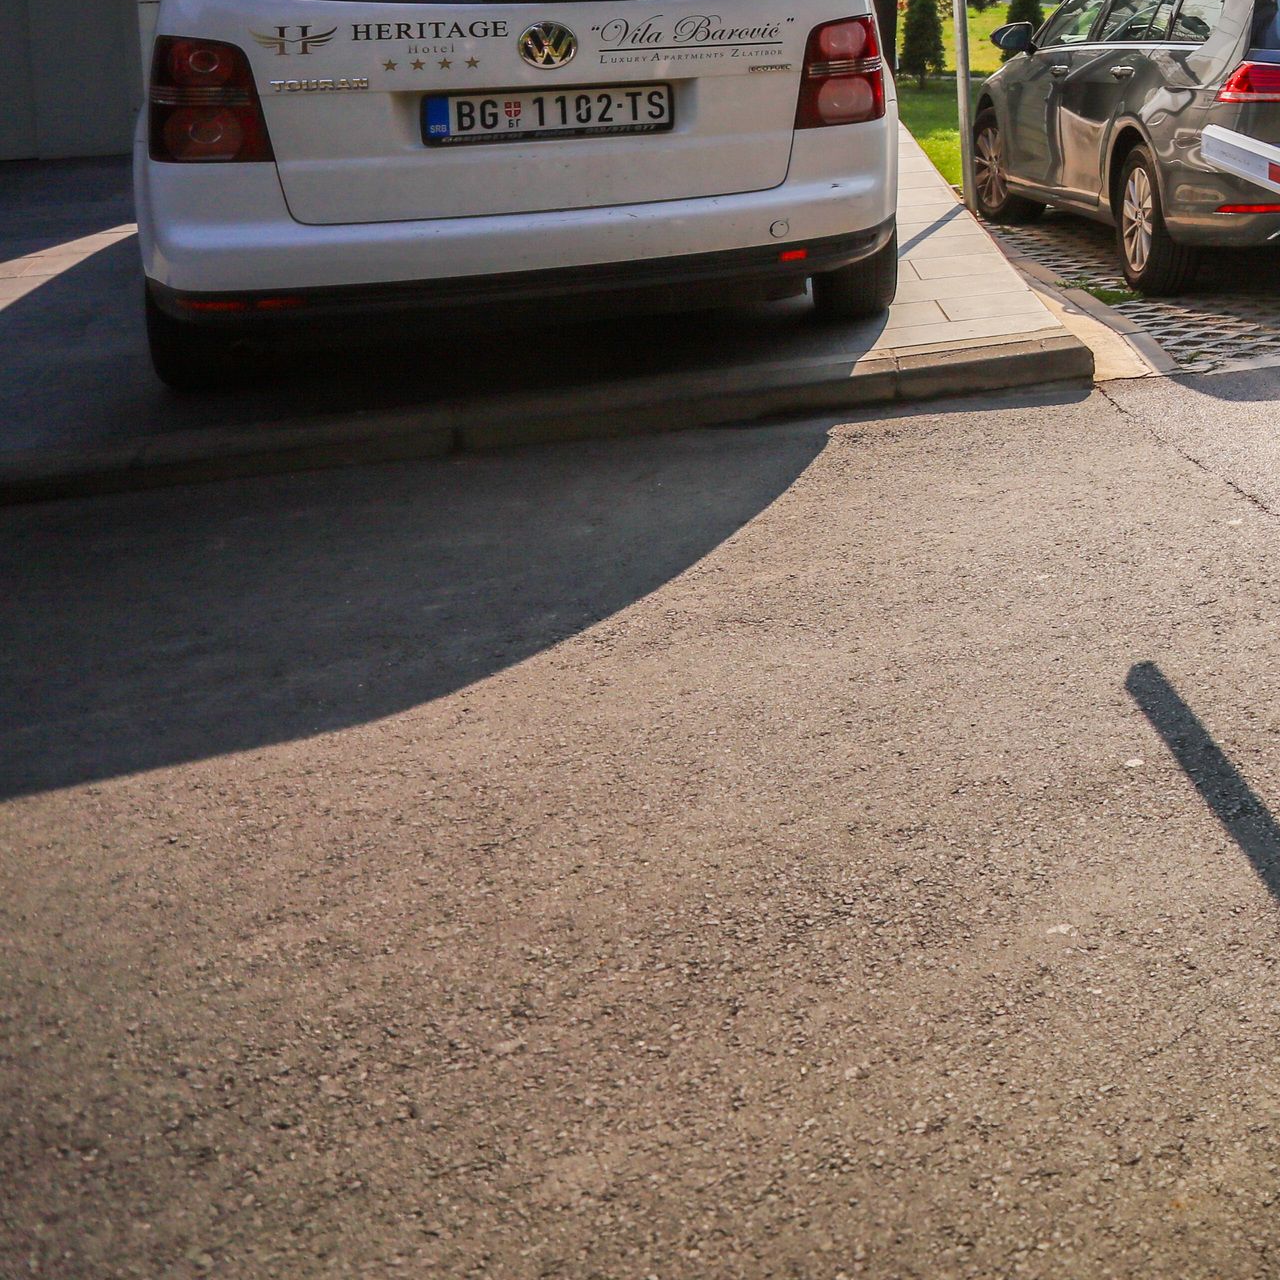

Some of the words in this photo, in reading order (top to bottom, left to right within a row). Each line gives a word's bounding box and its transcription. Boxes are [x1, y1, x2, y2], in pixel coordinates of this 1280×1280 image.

[351, 20, 509, 41] HERITAGE
[407, 43, 455, 54] Hotel
[599, 54, 648, 64] LUXURY
[731, 48, 783, 58] ZLATIBOR
[270, 77, 369, 92] TOURAN
[455, 99, 498, 132] BG
[430, 126, 447, 134] SRB
